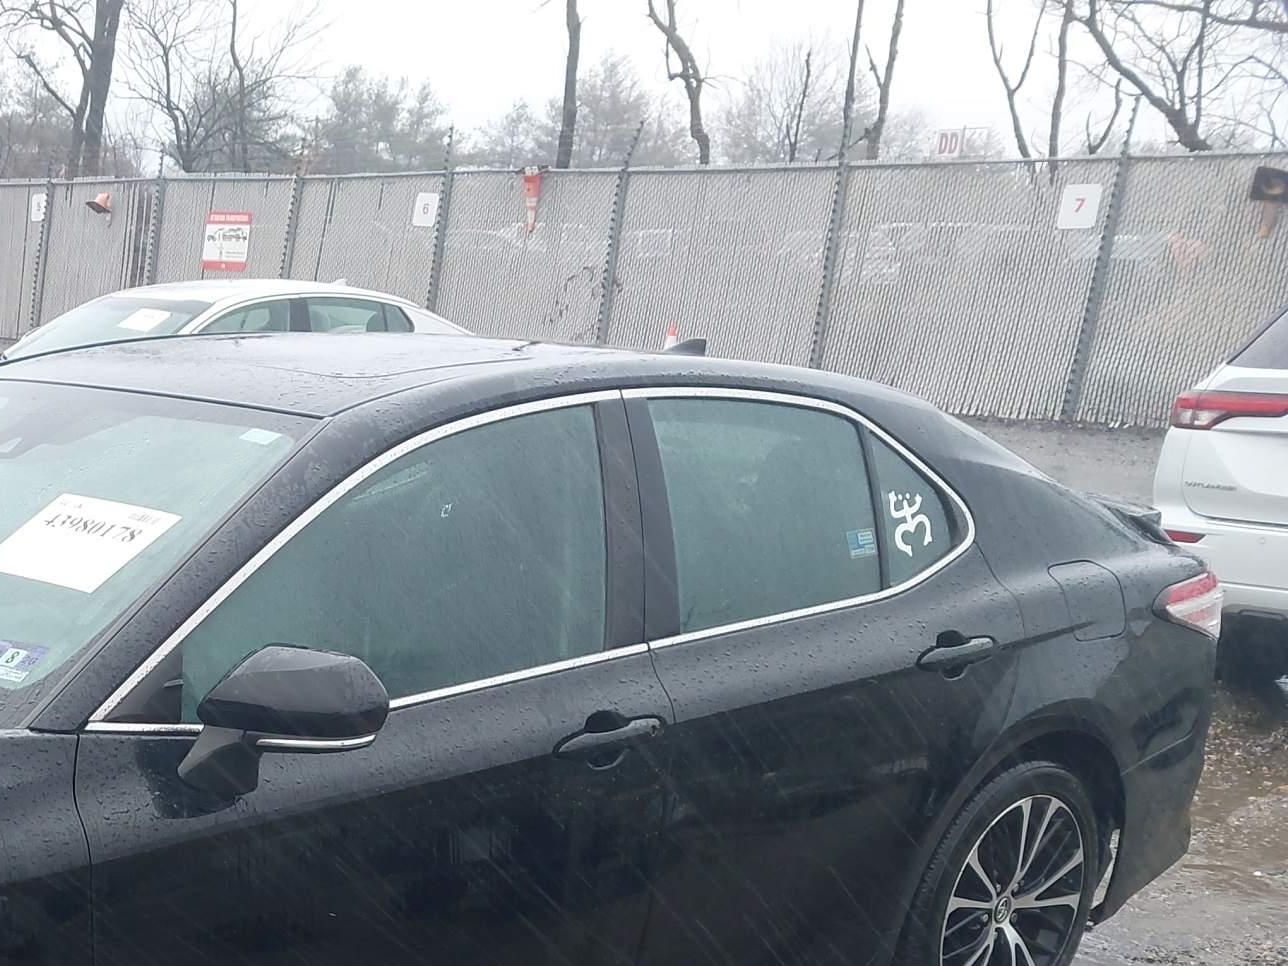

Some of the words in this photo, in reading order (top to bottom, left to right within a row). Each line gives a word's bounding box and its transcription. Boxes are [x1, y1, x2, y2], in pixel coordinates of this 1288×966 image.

[938, 132, 959, 155] DD
[423, 203, 430, 214] 6
[1075, 198, 1087, 212] 7
